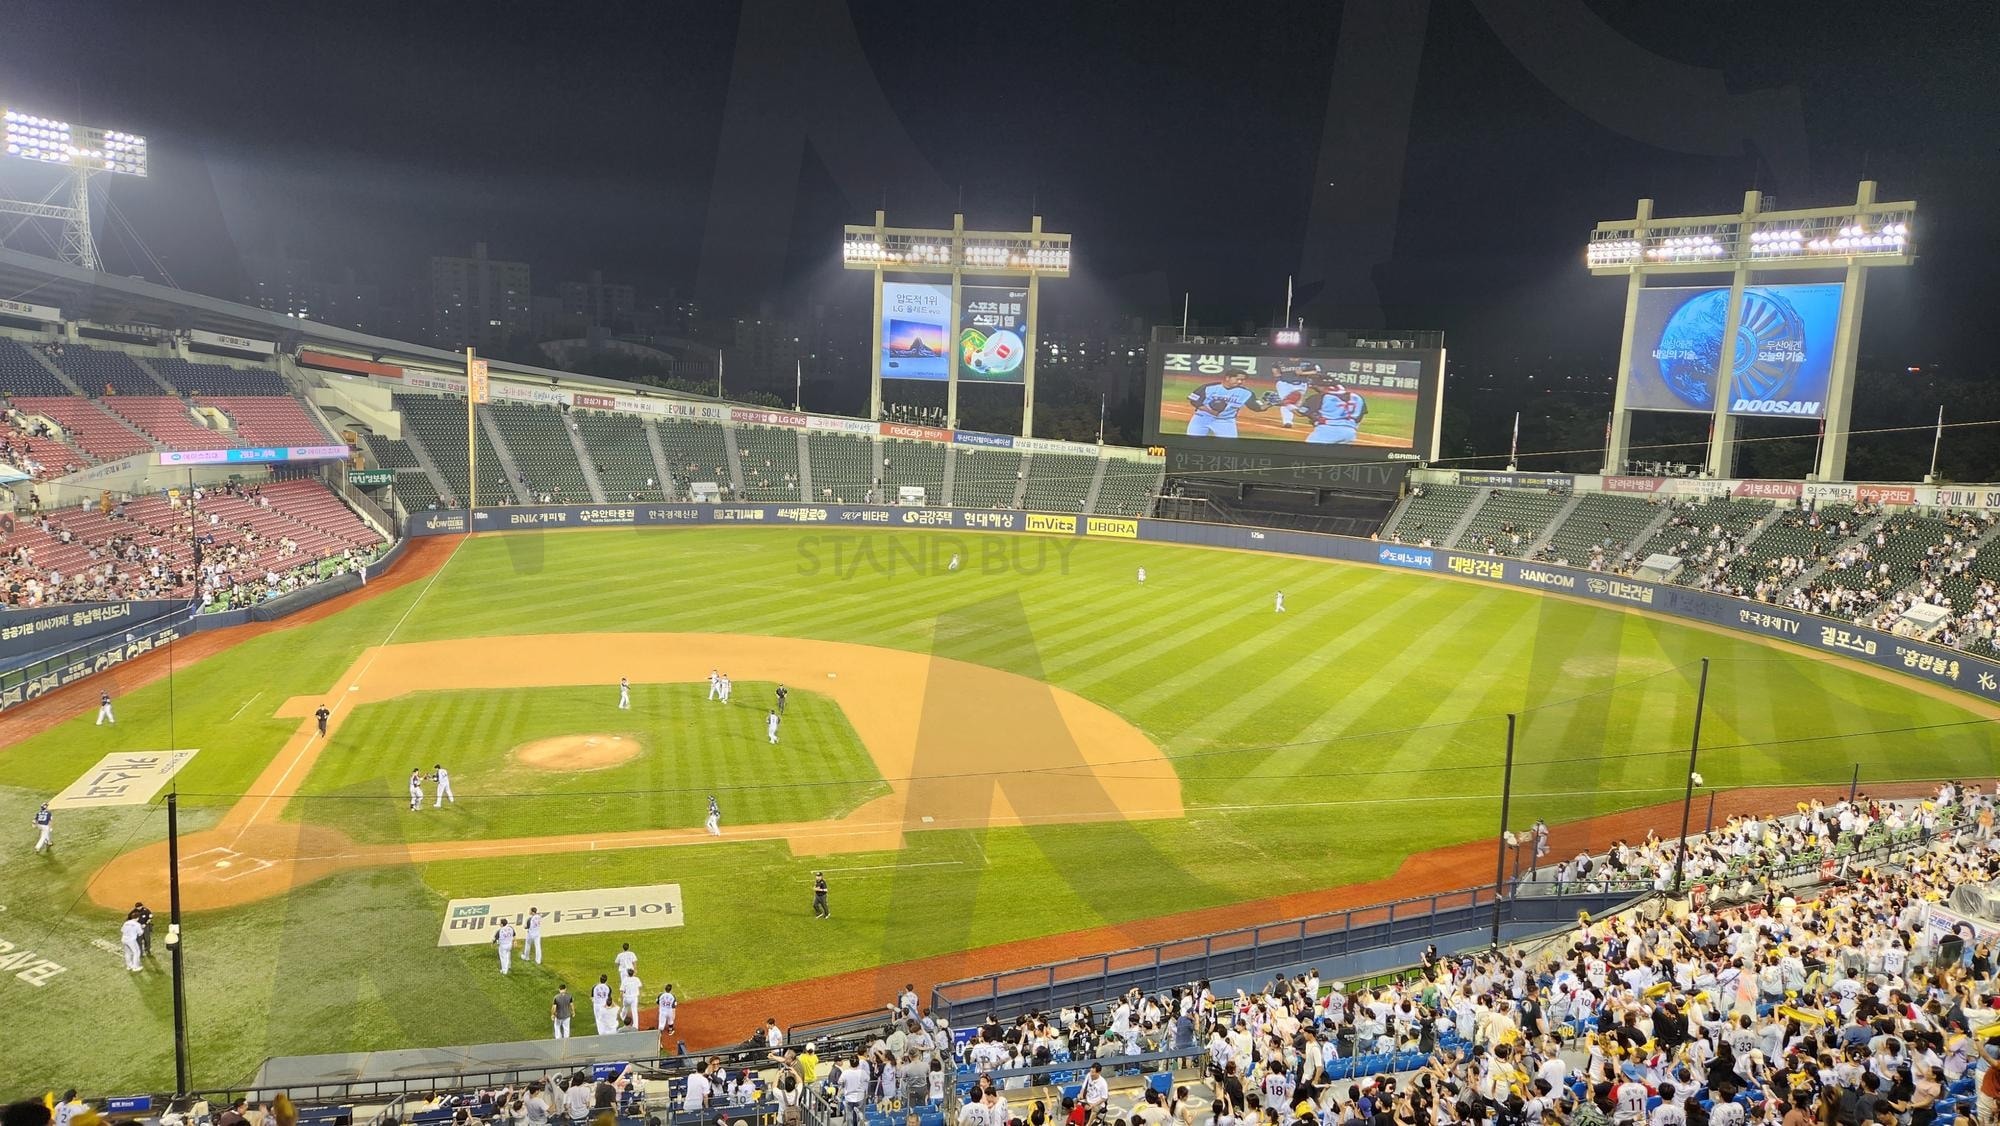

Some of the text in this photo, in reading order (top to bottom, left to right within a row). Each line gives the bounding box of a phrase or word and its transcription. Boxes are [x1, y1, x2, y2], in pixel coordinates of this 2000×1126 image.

[896, 294, 938, 306] 압도적 1위
[906, 306, 928, 314] 올레드
[968, 302, 998, 314] 스포츠
[973, 315, 1003, 327] 스포키
[1653, 350, 1677, 359] 내일의
[1758, 352, 1786, 362] 오늘의
[1732, 399, 1820, 415] DOOSAN
[778, 415, 788, 423] LG
[789, 416, 806, 425] CNS
[890, 426, 922, 437] redcap
[1175, 453, 1393, 485] 한국경제신문 한국경제TV
[1608, 479, 1654, 490] 달려라병원
[1744, 484, 1797, 495] 기부&RUN
[511, 511, 567, 524] BNK 캐피탈
[590, 509, 635, 518] 유안타증권
[649, 510, 698, 519] 한국경제신문
[862, 511, 889, 521] 비타란
[919, 510, 952, 524] 금강주택
[964, 512, 1014, 528] 현대해상
[1088, 521, 1136, 534] UBORA
[1389, 551, 1433, 567] 도미노피자
[1448, 556, 1504, 579] 대방건설
[1519, 569, 1574, 588] HANCOM
[1609, 581, 1653, 603] 대보건설
[1739, 608, 1800, 635] 한국경제TV
[1, 625, 35, 641] 공공기관
[1593, 968, 1605, 976] 22
[1843, 990, 1857, 998] 22
[1581, 997, 1591, 1006] 10
[1740, 1042, 1752, 1051] 33
[1270, 1085, 1283, 1096] 18
[1629, 1098, 1642, 1111] 11
